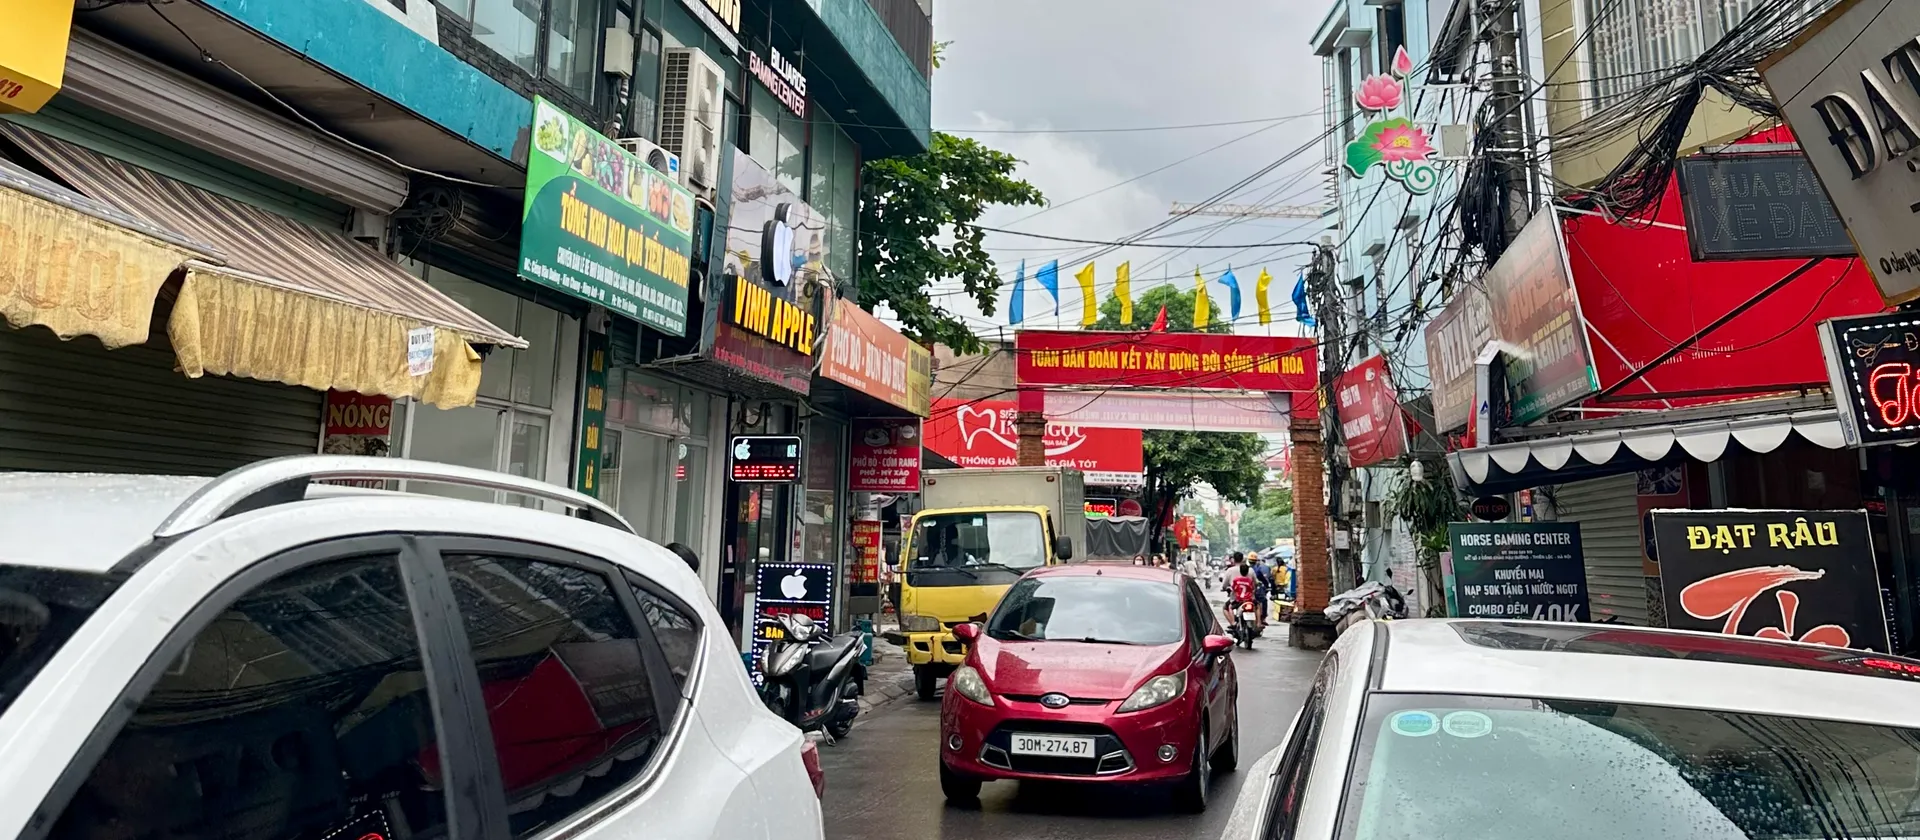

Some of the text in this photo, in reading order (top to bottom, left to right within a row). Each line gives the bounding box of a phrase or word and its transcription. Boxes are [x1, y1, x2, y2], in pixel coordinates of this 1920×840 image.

[750, 51, 805, 119] GAMING CENTER
[771, 46, 807, 97] BILLIARDS
[1708, 172, 1771, 199] MUA
[560, 180, 588, 239] TỔNG
[587, 206, 608, 248] KHO
[607, 217, 625, 258] HOA
[626, 223, 644, 268] QUẢ
[1707, 202, 1762, 242] XE
[735, 275, 772, 337] VINH
[771, 297, 815, 356] APPLE
[831, 315, 851, 367] PHỞ
[849, 326, 861, 373] BÒ
[865, 334, 882, 382] BÚN
[891, 347, 908, 394] HUẾ
[1031, 345, 1304, 375] TOÀN DÂN ĐOÀN KẾT XÂY DỰNG ĐỜI SỐNG VĂN HÓA
[328, 397, 390, 429] NÓNG
[853, 455, 867, 467] PHỞ
[898, 457, 918, 467] RANG
[1059, 458, 1077, 468] GIÁ
[1078, 457, 1098, 468] TỐT
[861, 476, 878, 484] BÚN
[890, 475, 907, 485] HUẾ
[1460, 533, 1571, 546] HORSE GAMING CENTER
[1686, 517, 1839, 555] ĐẠT RÂU
[1494, 565, 1544, 582] KHUYẾN MẠI
[1240, 585, 1247, 598] 7
[1464, 581, 1578, 598] NẠP 50K TẶNG 1 NƯỚC NGỌT
[1468, 602, 1580, 622] COMBO ĐÊM 40K
[1018, 738, 1088, 754] 30M-274.87
